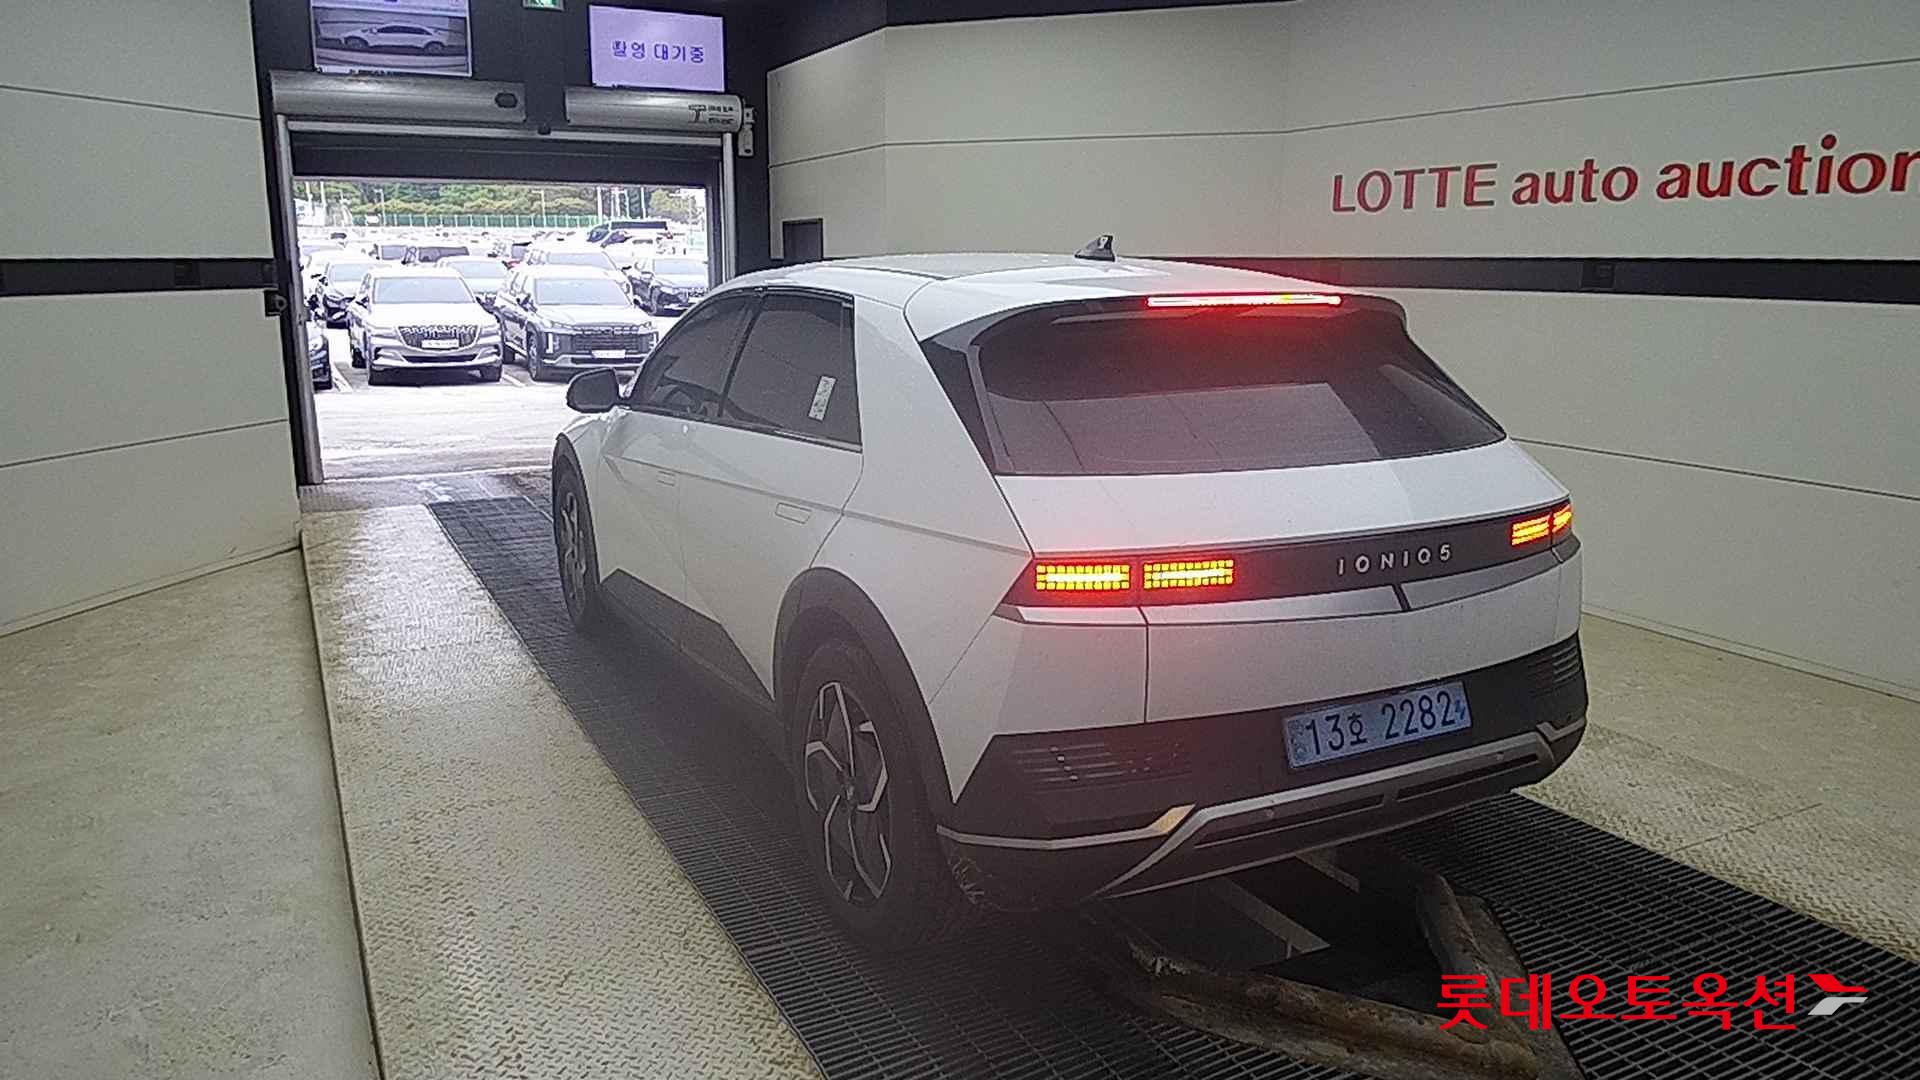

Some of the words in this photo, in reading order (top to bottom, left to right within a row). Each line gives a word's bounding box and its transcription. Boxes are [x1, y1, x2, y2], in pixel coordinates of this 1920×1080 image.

[654, 43, 704, 64] 대기중
[1332, 162, 1498, 212] LOTTE
[1511, 158, 1639, 205] auto
[1305, 712, 1367, 756] 13호
[1381, 690, 1456, 740] 2282
